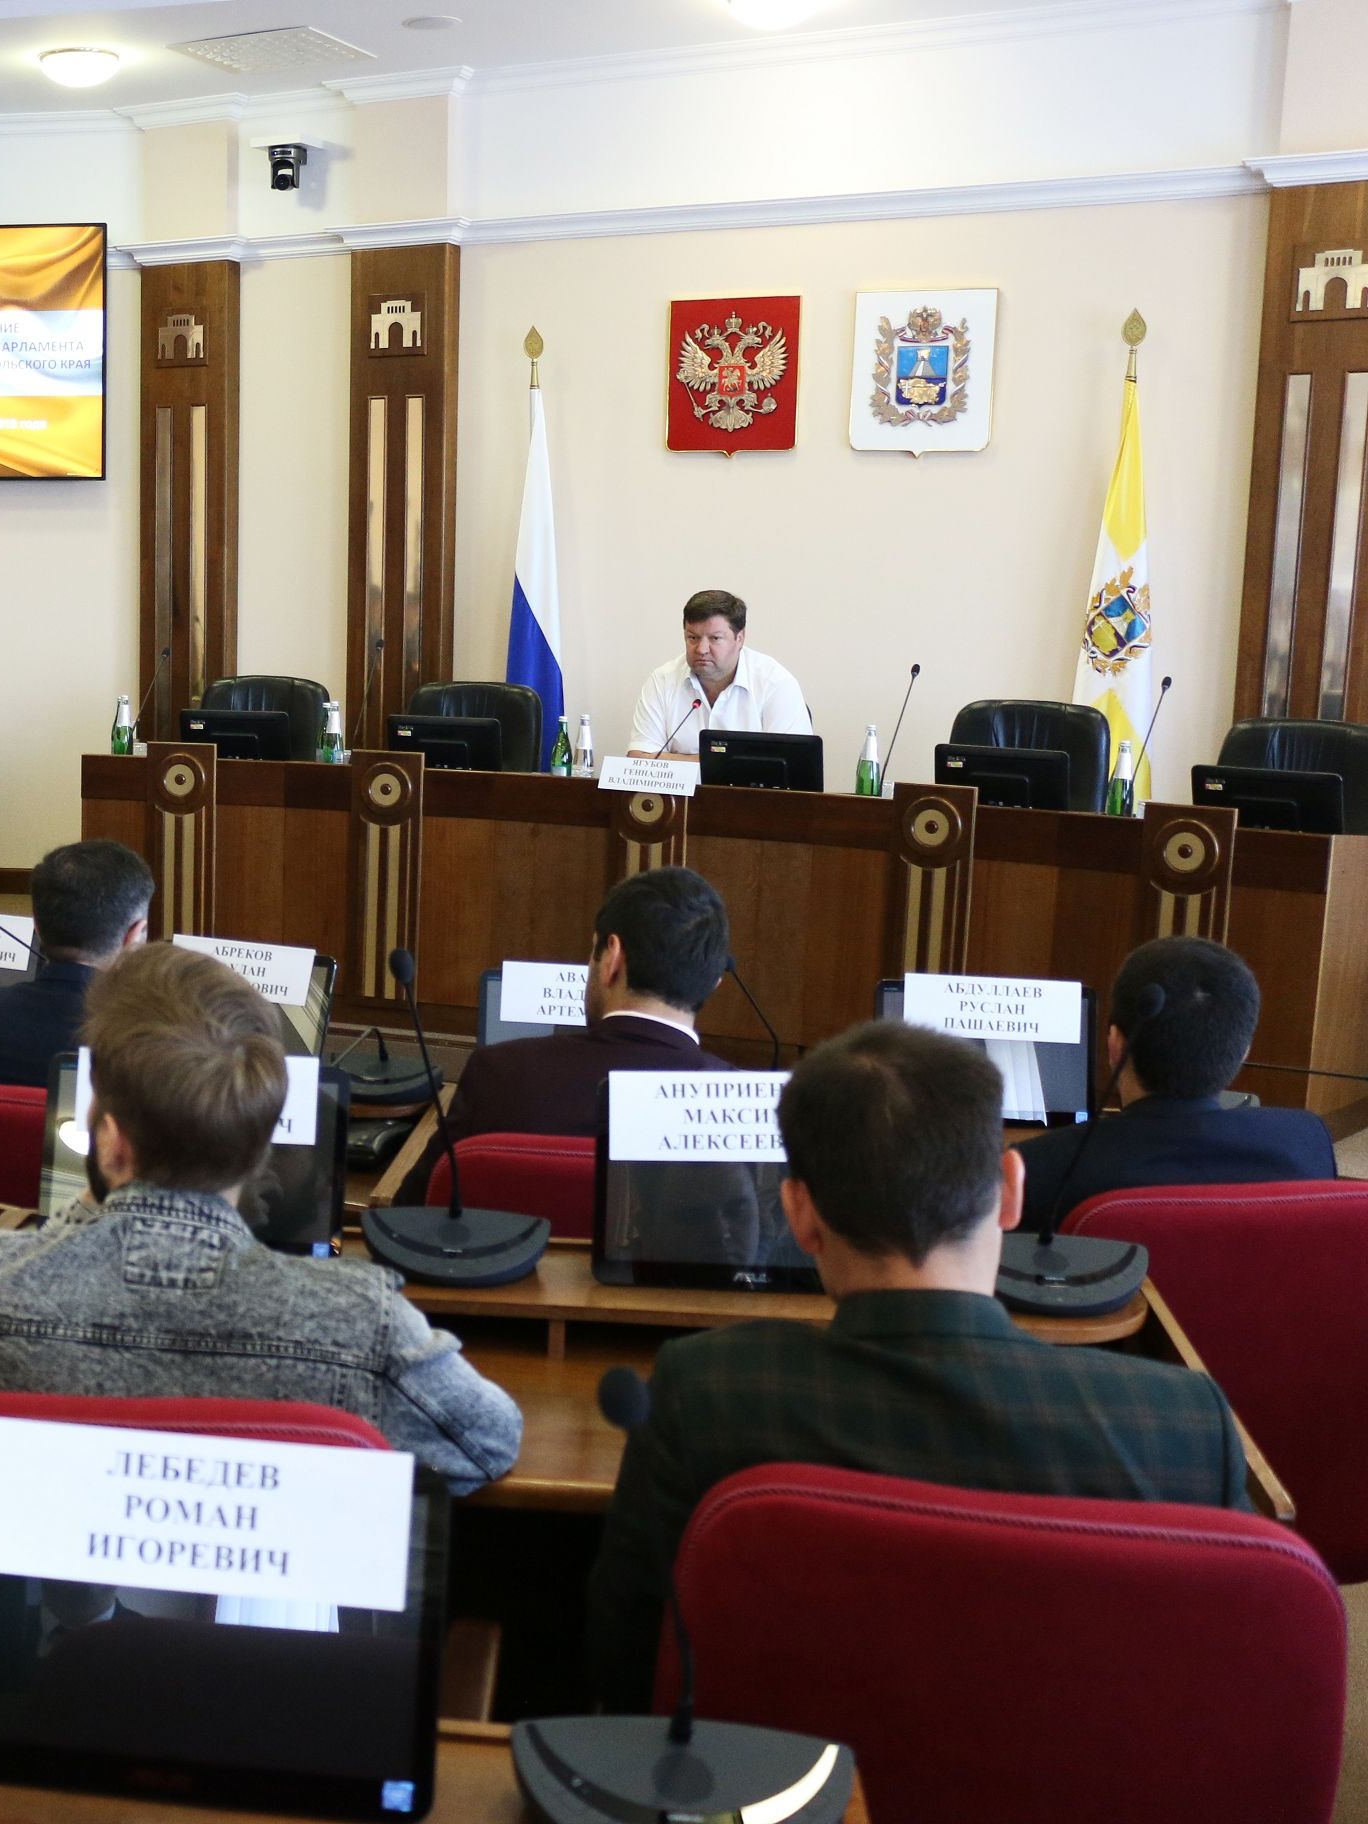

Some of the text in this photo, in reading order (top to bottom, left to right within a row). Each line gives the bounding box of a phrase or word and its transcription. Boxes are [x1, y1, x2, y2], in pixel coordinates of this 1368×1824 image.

[60, 359, 92, 369] КРАЯ
[632, 759, 670, 769] ЯГУБОВ
[623, 768, 674, 779] ГЕННАДИЙ
[608, 777, 685, 790] ВЛАДИМИРОВИЧ
[543, 987, 586, 1001] ВЛАД
[943, 982, 1043, 998] АБДУЛЛАЕВ
[536, 1004, 586, 1017] АРТЕМ
[959, 1001, 1025, 1015] РУСЛАН
[944, 1017, 1040, 1033] ПАШАЕВИЧ
[655, 1082, 785, 1099] АНУПРИЕН
[684, 1108, 771, 1124] МАКСИ
[658, 1133, 784, 1151] АЛЕКСЕЕВ
[106, 1449, 282, 1492] ЛЕБЕДЕВ
[124, 1494, 259, 1531] РОМАН
[86, 1531, 292, 1577] ИГОРЕВИЧ
